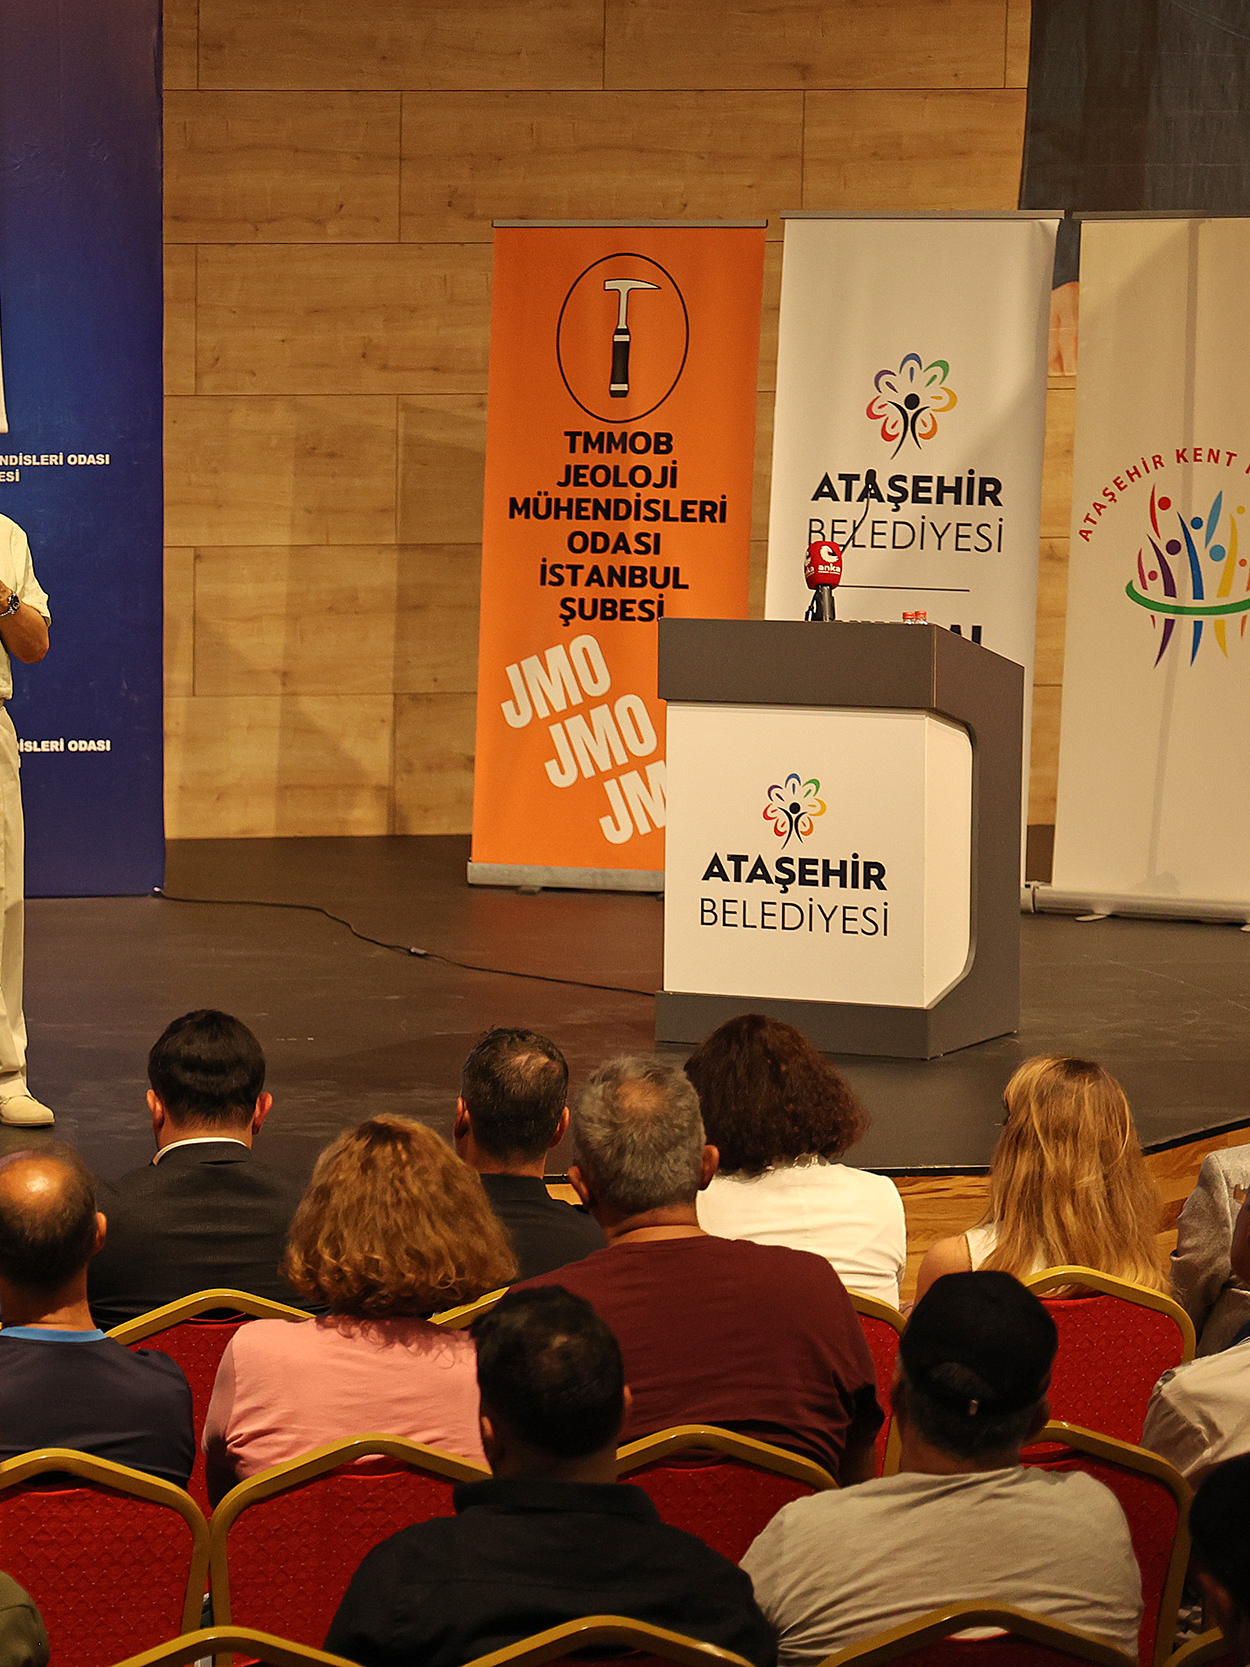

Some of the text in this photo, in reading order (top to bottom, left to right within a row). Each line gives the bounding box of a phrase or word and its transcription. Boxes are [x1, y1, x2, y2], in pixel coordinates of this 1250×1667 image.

[564, 431, 673, 454] TMMOB
[67, 454, 110, 465] ODASI
[556, 459, 677, 488] JEOLOJİ
[508, 491, 727, 523] MÜHENDİSLERİ
[811, 469, 1003, 513] ATAŞEHİR
[1078, 447, 1238, 542] ATAŞEHİR KENT
[567, 531, 661, 555] ODASI
[808, 515, 1004, 553] BELEDİYESİ
[540, 558, 689, 589] İSTANBUL
[818, 563, 841, 572] anka
[559, 594, 664, 626] ŞUBESİ
[500, 634, 611, 729] JMO
[67, 739, 111, 752] ODASI
[544, 694, 658, 788] JMO
[701, 852, 888, 894] ATAŞEHİR
[700, 897, 889, 937] BELEDİYESİ
